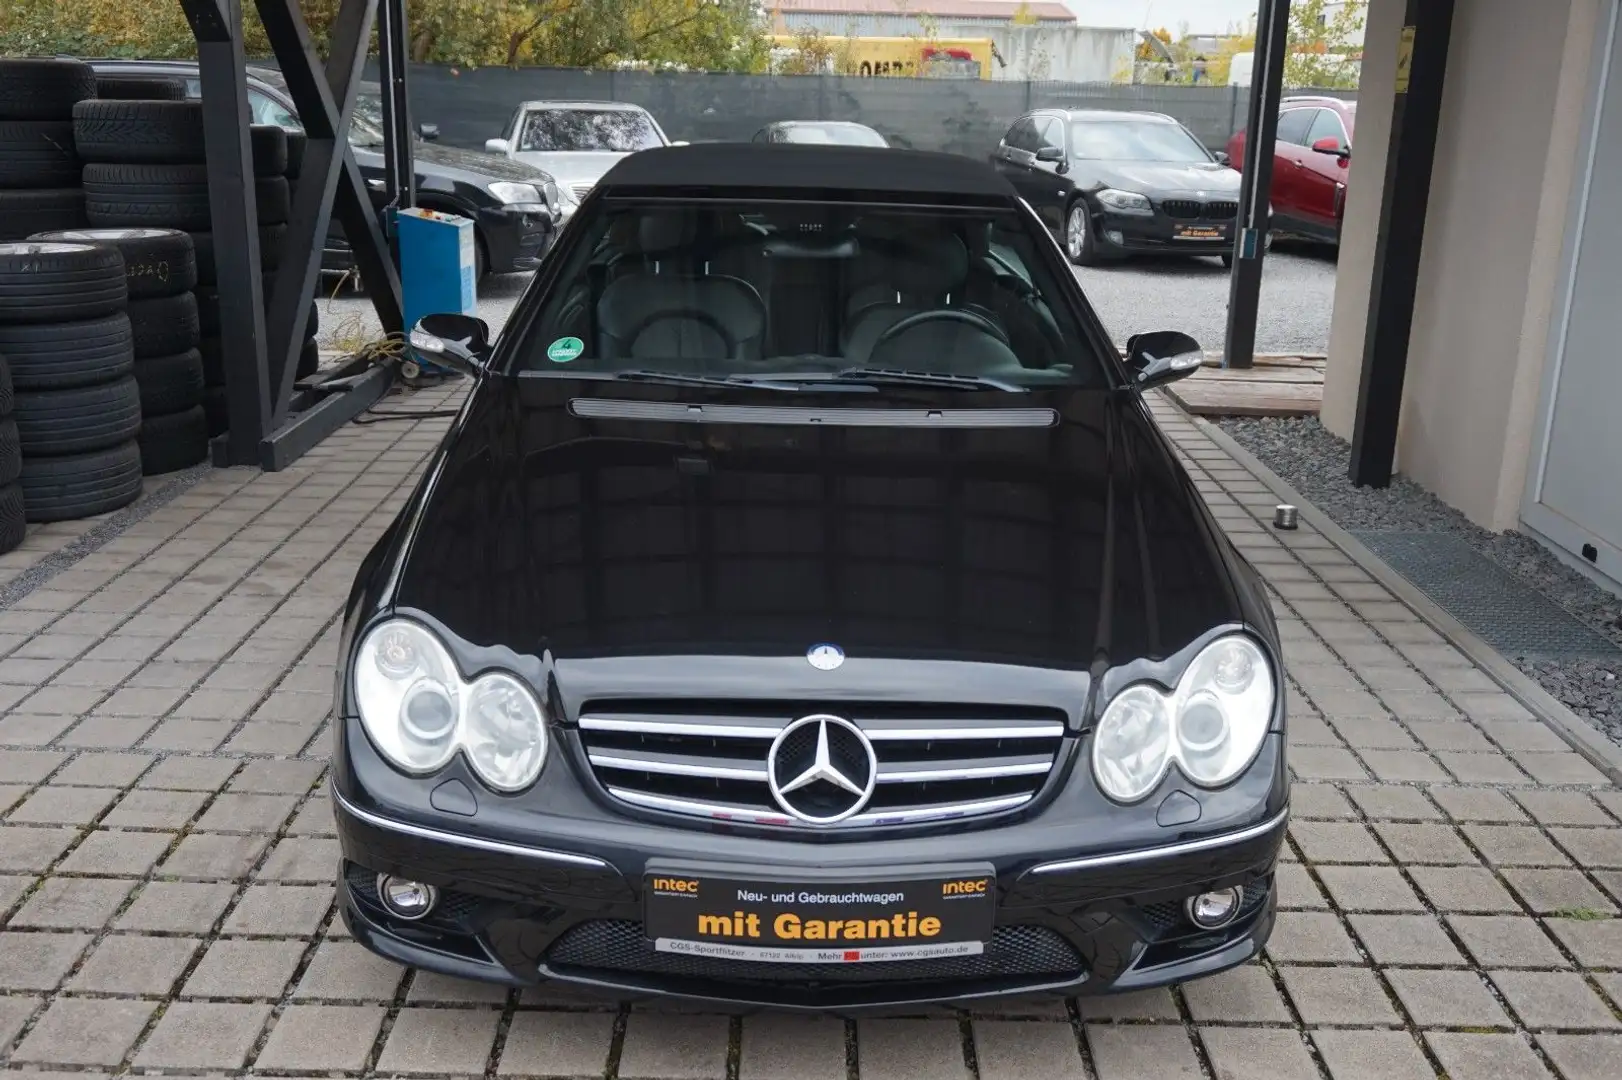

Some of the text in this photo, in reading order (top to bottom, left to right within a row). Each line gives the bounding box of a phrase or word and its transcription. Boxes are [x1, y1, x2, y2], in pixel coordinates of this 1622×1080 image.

[562, 339, 571, 349] 4
[737, 889, 904, 904] Neu- und Gebrauchtwagen
[698, 911, 942, 939] mit Garantie
[818, 952, 842, 960] Mehr
[891, 946, 968, 958] www.cgsauto.de
